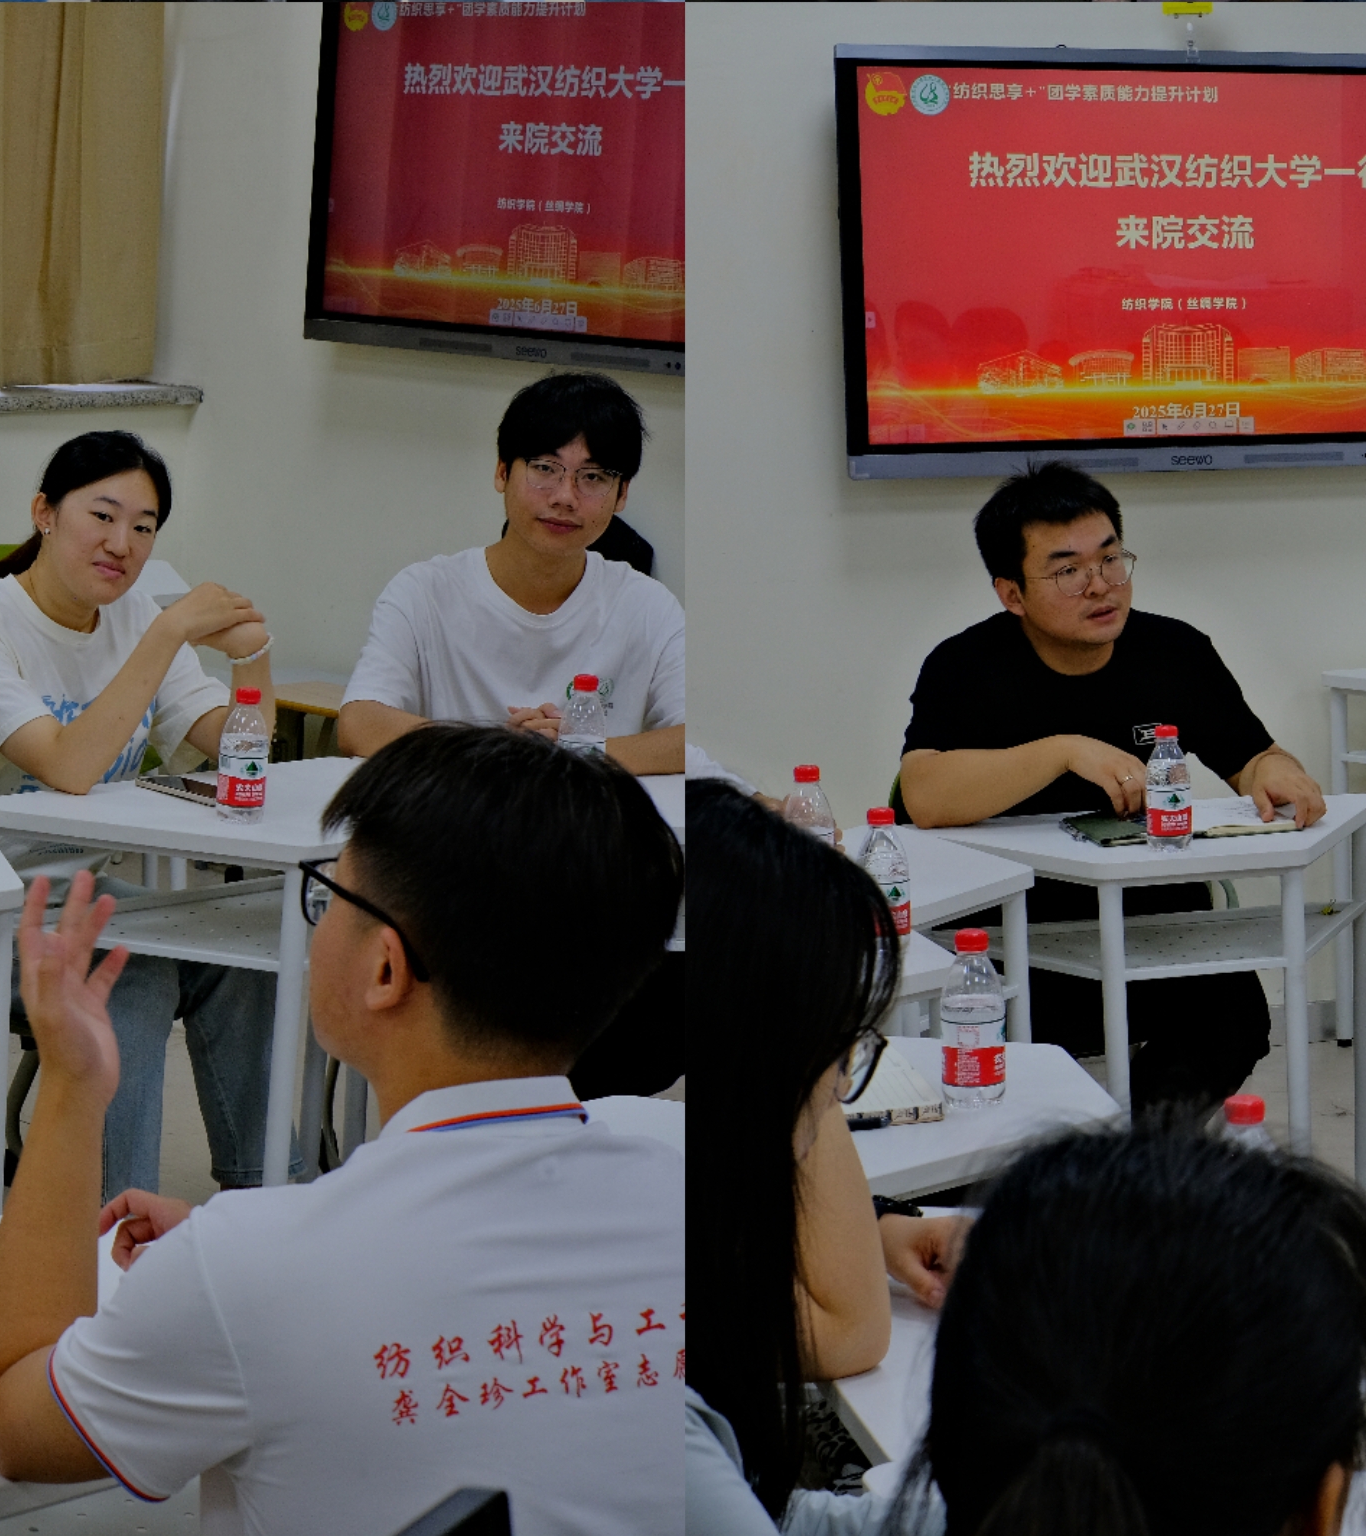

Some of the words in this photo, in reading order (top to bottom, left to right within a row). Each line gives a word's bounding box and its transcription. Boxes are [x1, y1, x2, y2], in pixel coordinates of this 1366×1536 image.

[498, 120, 604, 157] 来院交流
[1115, 214, 1255, 251] 来院交流
[496, 296, 578, 317] 2025年6月27日
[1132, 401, 1241, 419] 2025年6月27日
[1170, 453, 1214, 466] seewo
[373, 1302, 685, 1381] 纺织科学与工
